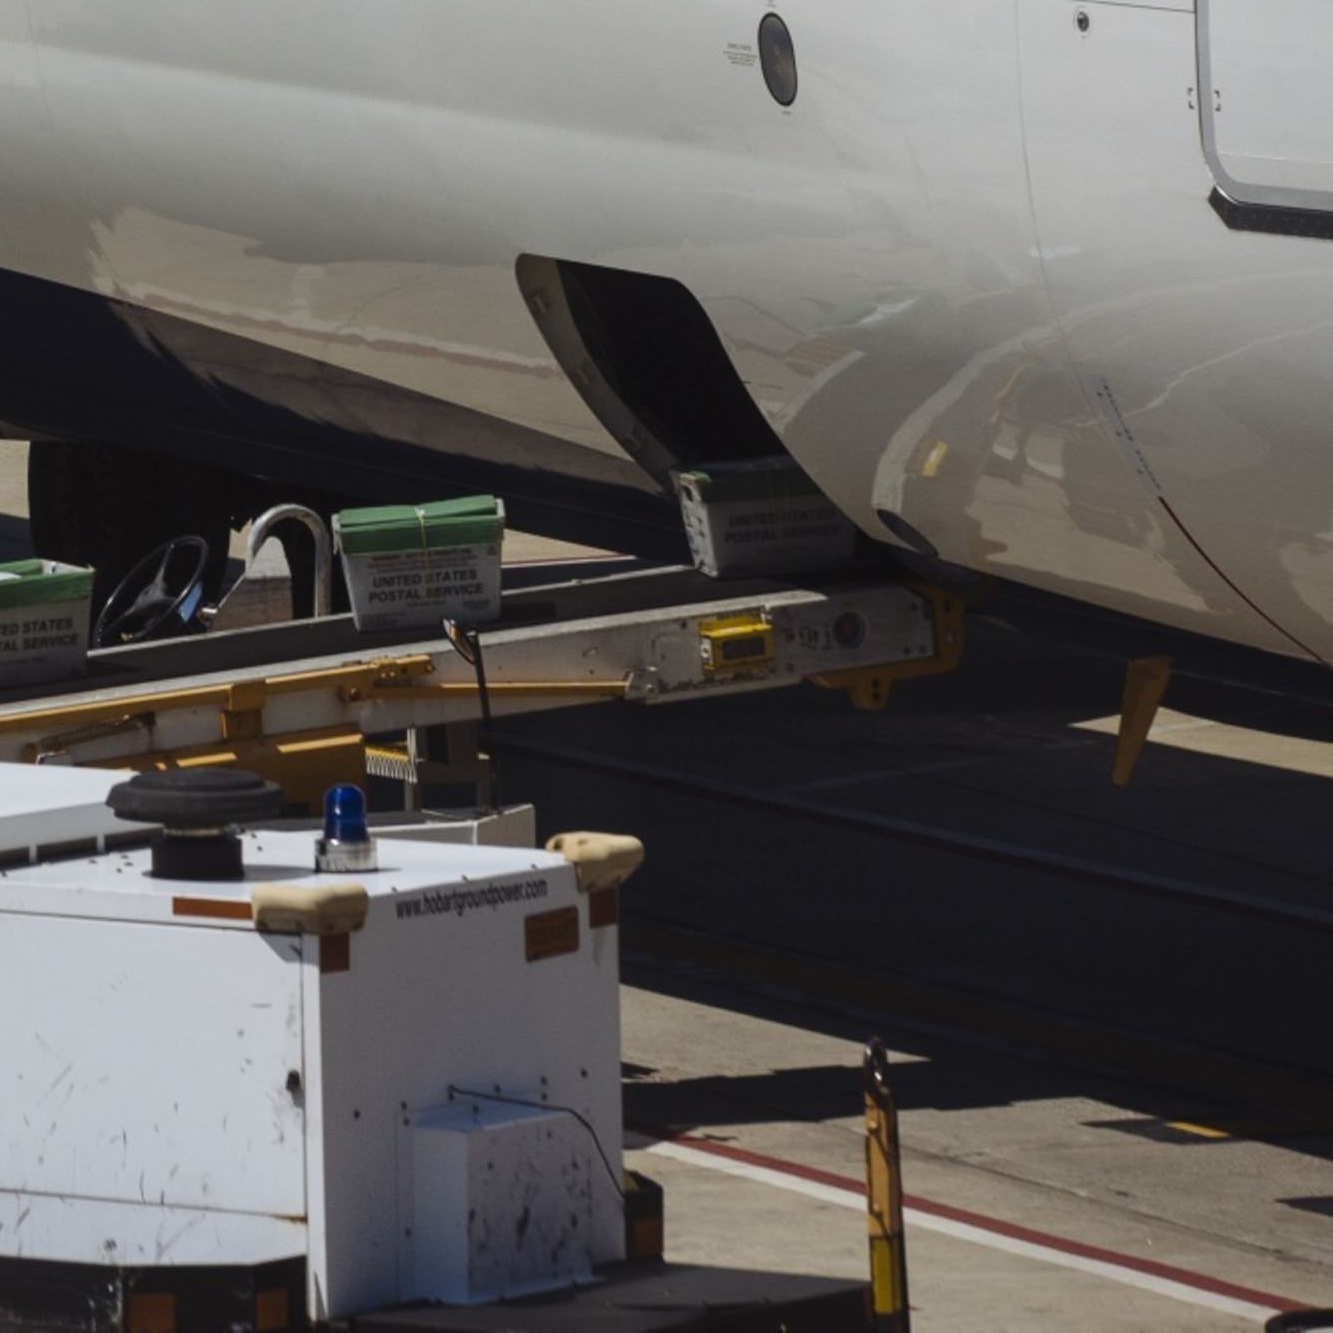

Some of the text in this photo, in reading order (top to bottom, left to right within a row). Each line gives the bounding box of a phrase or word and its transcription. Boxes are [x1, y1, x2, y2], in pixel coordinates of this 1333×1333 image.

[373, 573, 422, 589] UNITED
[369, 583, 484, 603] POSTAL SERVICE
[22, 617, 73, 634] STATES
[22, 633, 79, 650] SERVICE
[395, 878, 549, 919] www.hobartgroundpower.com
